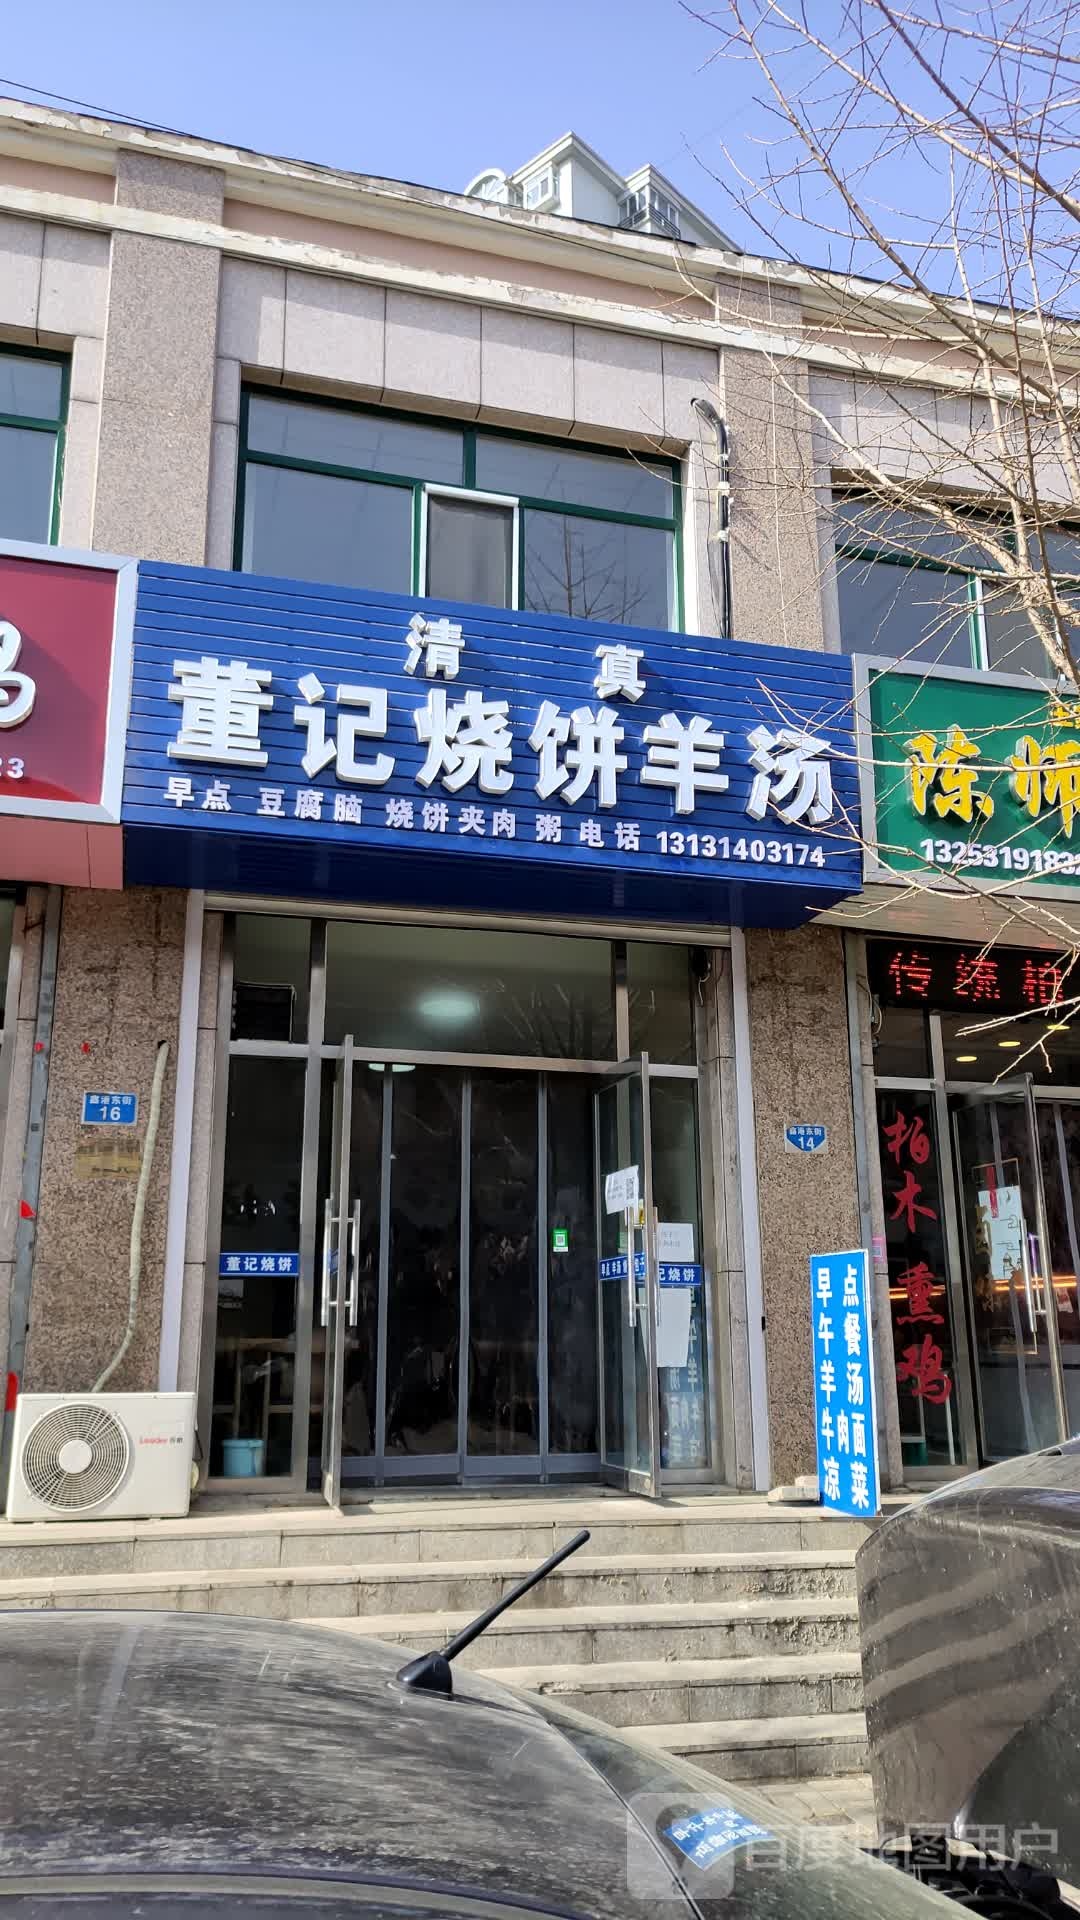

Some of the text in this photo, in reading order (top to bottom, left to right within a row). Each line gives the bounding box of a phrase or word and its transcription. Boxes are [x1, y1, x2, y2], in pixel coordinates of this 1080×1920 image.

[403, 613, 646, 703] 清真
[167, 656, 832, 828] 董记烧饼羊汤
[0, 757, 24, 779] 3
[164, 777, 826, 867] 早点 豆腐脑 烧饼夹肉 粥 电话 13131403174
[100, 1106, 121, 1121] 16
[798, 1136, 815, 1149] 14
[226, 1256, 292, 1271] 董记烧饼
[816, 1264, 860, 1308] 早点
[818, 1312, 861, 1356] 午餐
[820, 1360, 863, 1406] 羊汤
[821, 1406, 866, 1457] 牛肉面
[823, 1455, 870, 1510] 凉菜
